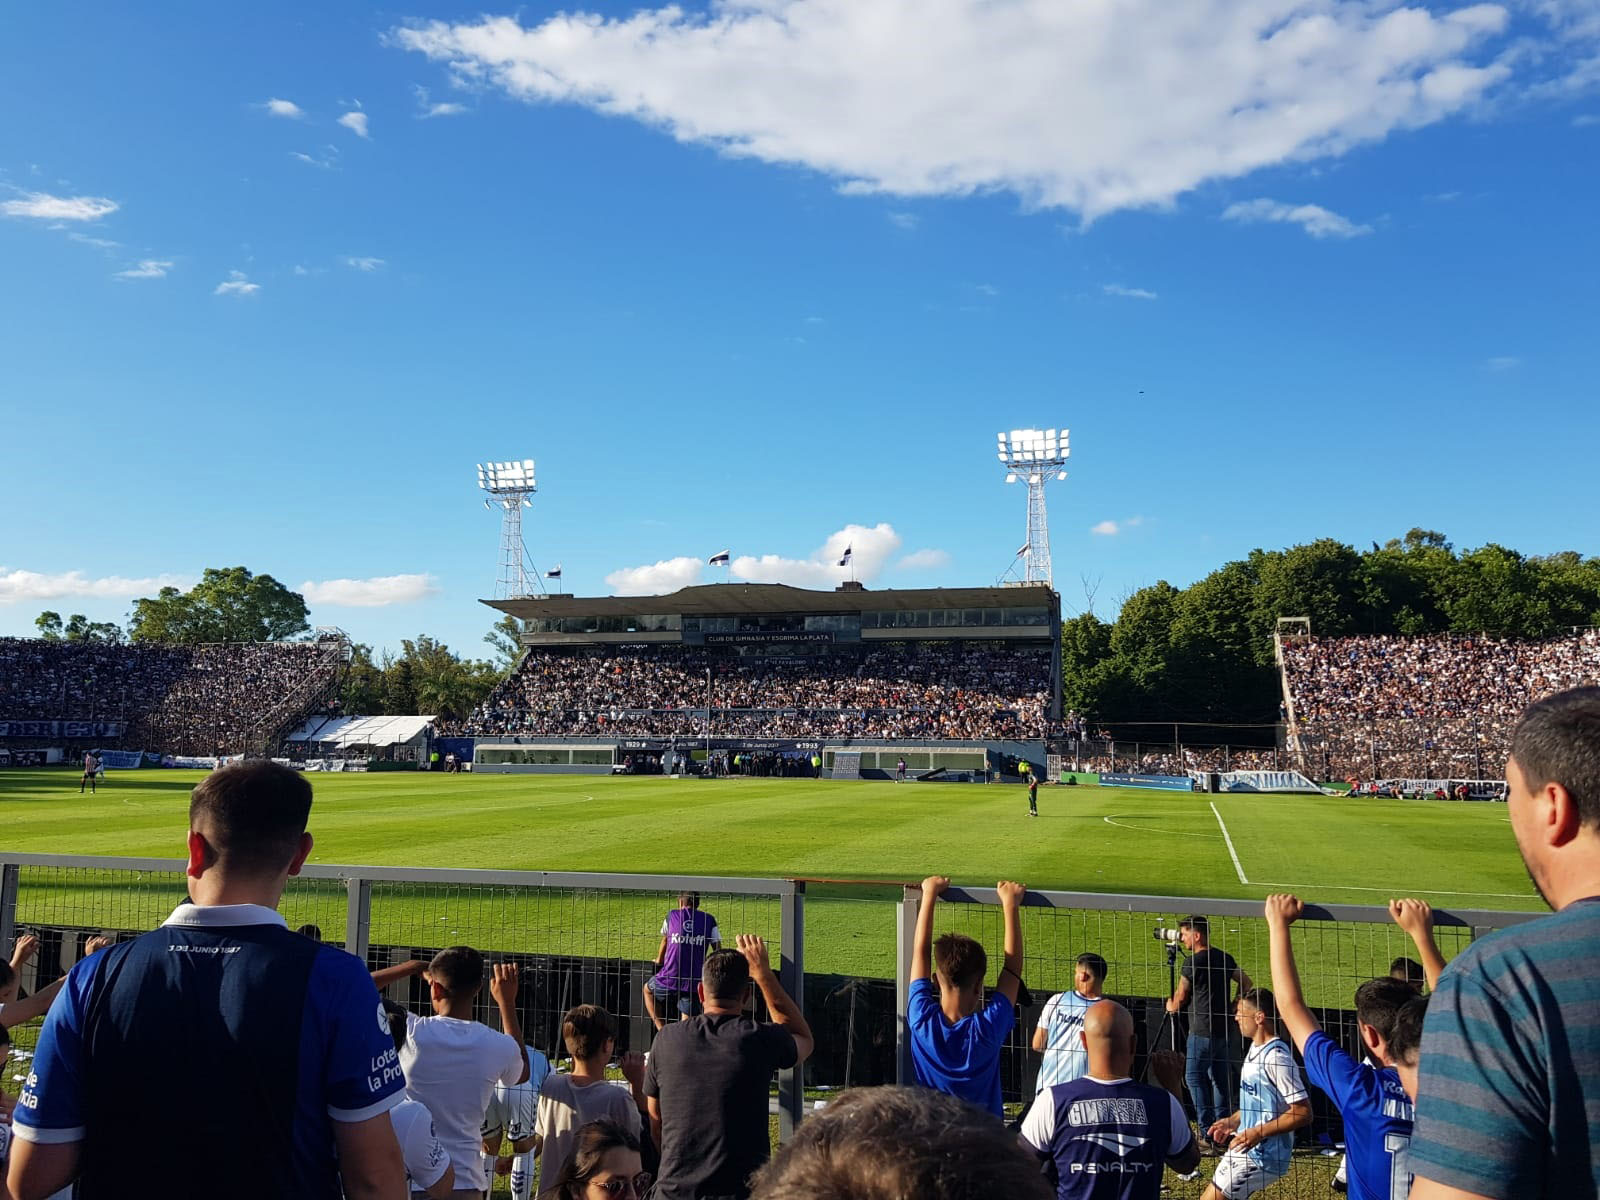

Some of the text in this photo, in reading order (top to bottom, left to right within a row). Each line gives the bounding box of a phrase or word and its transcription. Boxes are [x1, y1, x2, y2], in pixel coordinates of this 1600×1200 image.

[190, 945, 219, 954] JUNIO
[367, 1075, 382, 1093] la
[1068, 1098, 1149, 1127] GIMNASIA
[1070, 1161, 1153, 1174] PENALTY
